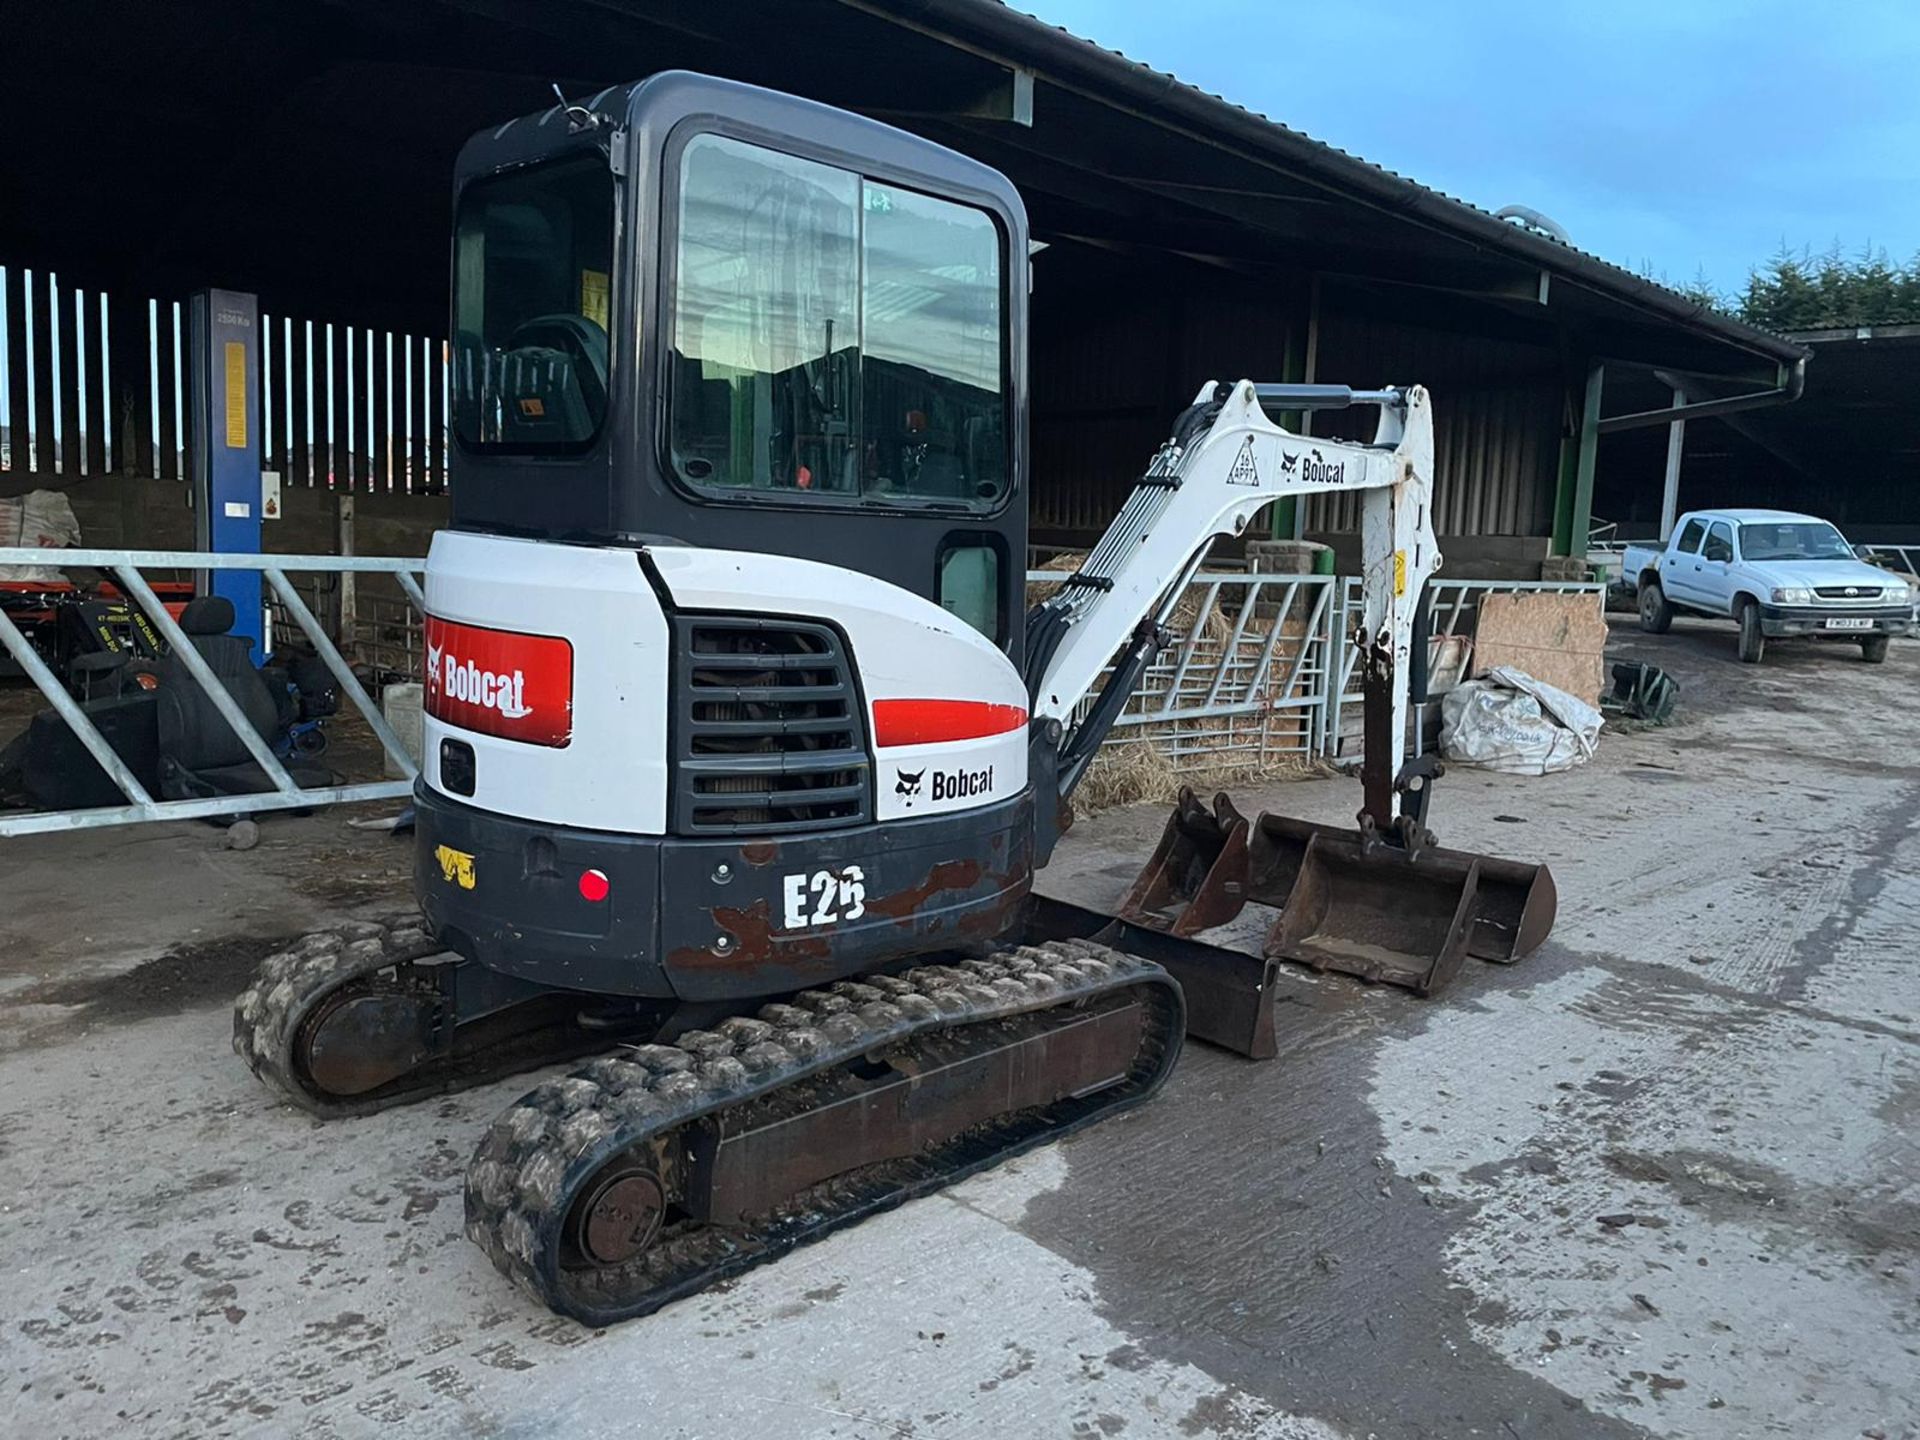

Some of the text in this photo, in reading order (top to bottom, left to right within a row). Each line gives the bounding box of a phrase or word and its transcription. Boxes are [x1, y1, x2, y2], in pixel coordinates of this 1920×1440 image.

[1241, 454, 1250, 467] 16
[1302, 458, 1344, 484] Bobcat
[445, 654, 526, 714] Bobcat
[931, 765, 993, 801] Bobcat
